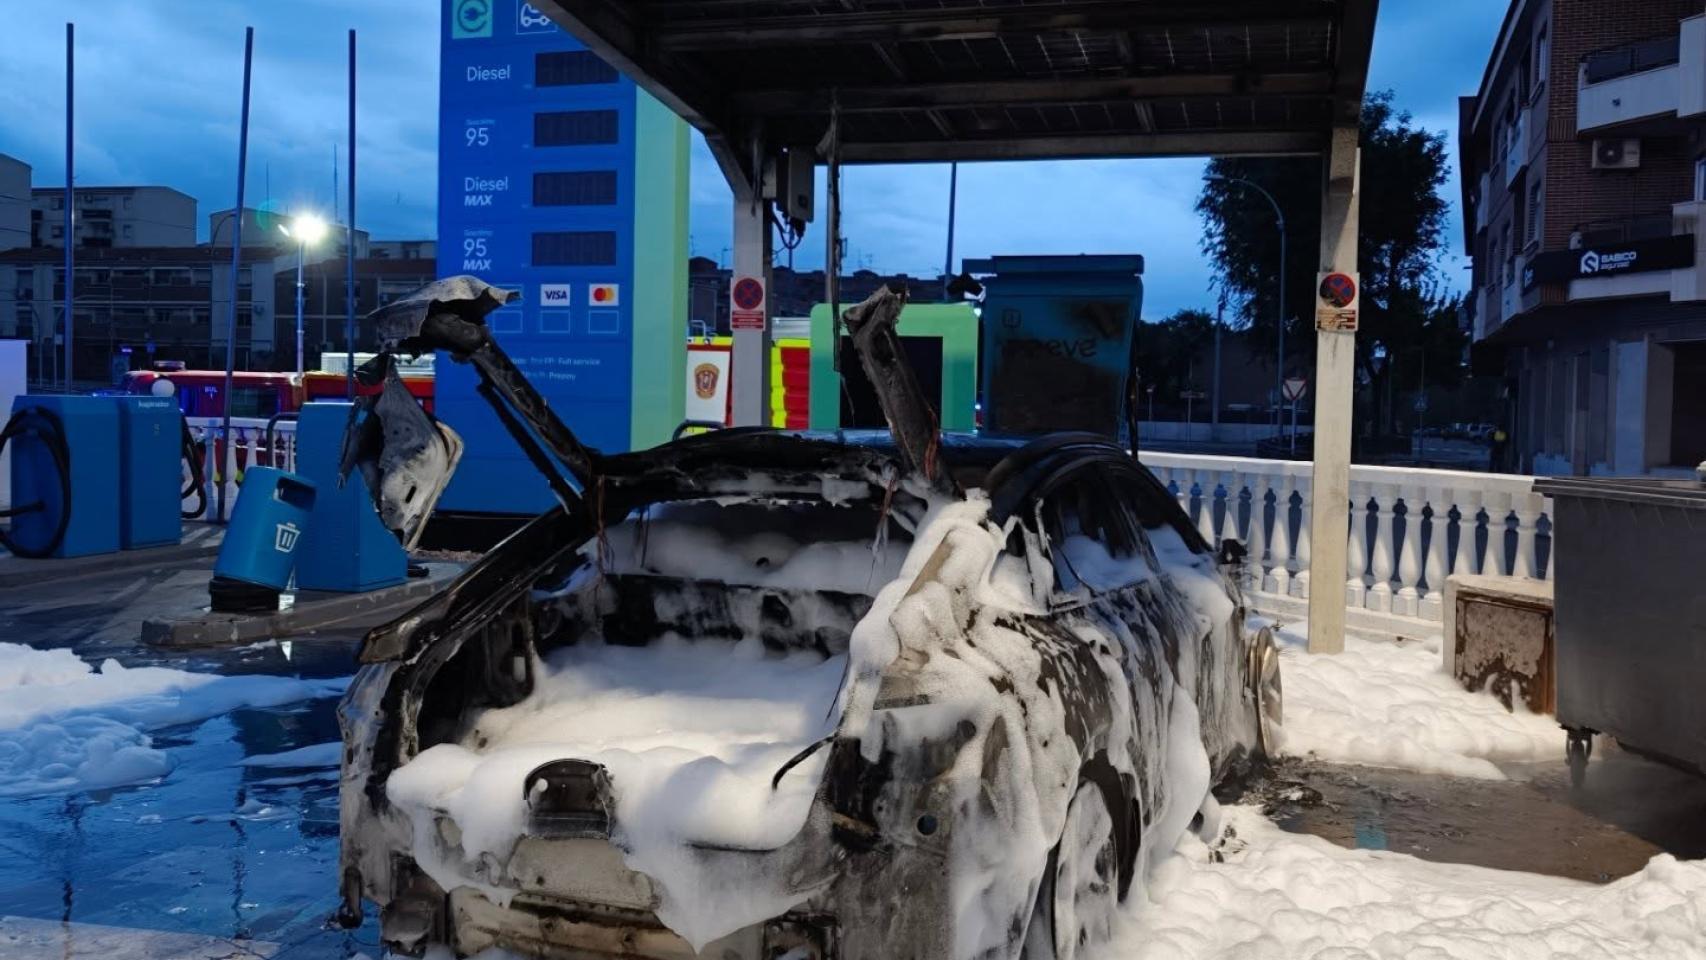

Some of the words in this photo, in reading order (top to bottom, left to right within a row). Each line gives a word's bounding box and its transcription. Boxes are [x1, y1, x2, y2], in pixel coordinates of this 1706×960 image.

[467, 65, 511, 81] Diesel
[466, 127, 489, 146] 95
[465, 176, 509, 192] Diesel
[464, 195, 493, 206] MAX
[463, 238, 487, 257] 95
[463, 259, 492, 270] MAX
[544, 290, 568, 300] VISA
